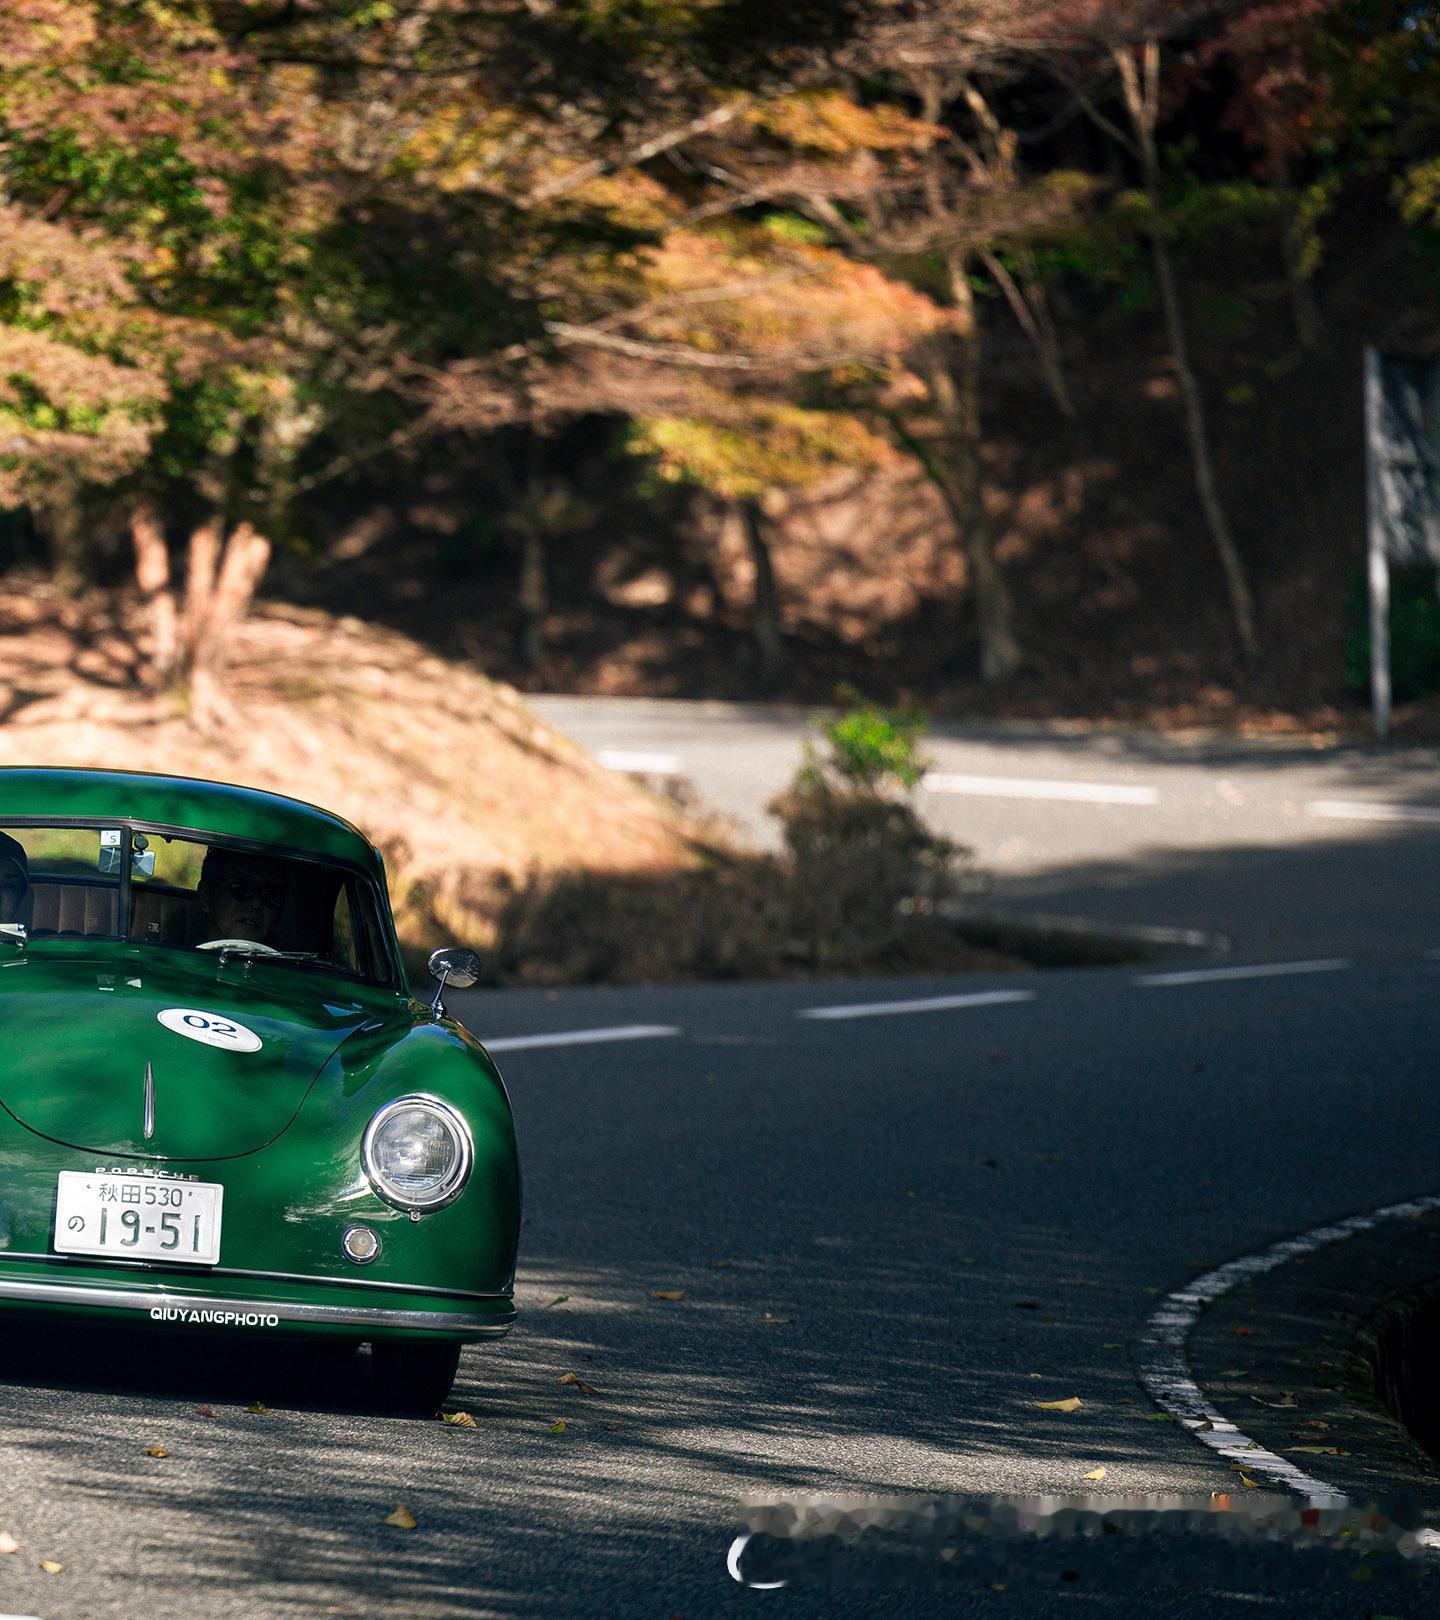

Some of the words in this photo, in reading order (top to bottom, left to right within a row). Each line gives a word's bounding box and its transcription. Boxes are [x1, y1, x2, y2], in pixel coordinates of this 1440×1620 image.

[183, 1015, 238, 1039] 02
[67, 1215, 85, 1232] の
[99, 1207, 201, 1253] 19-51
